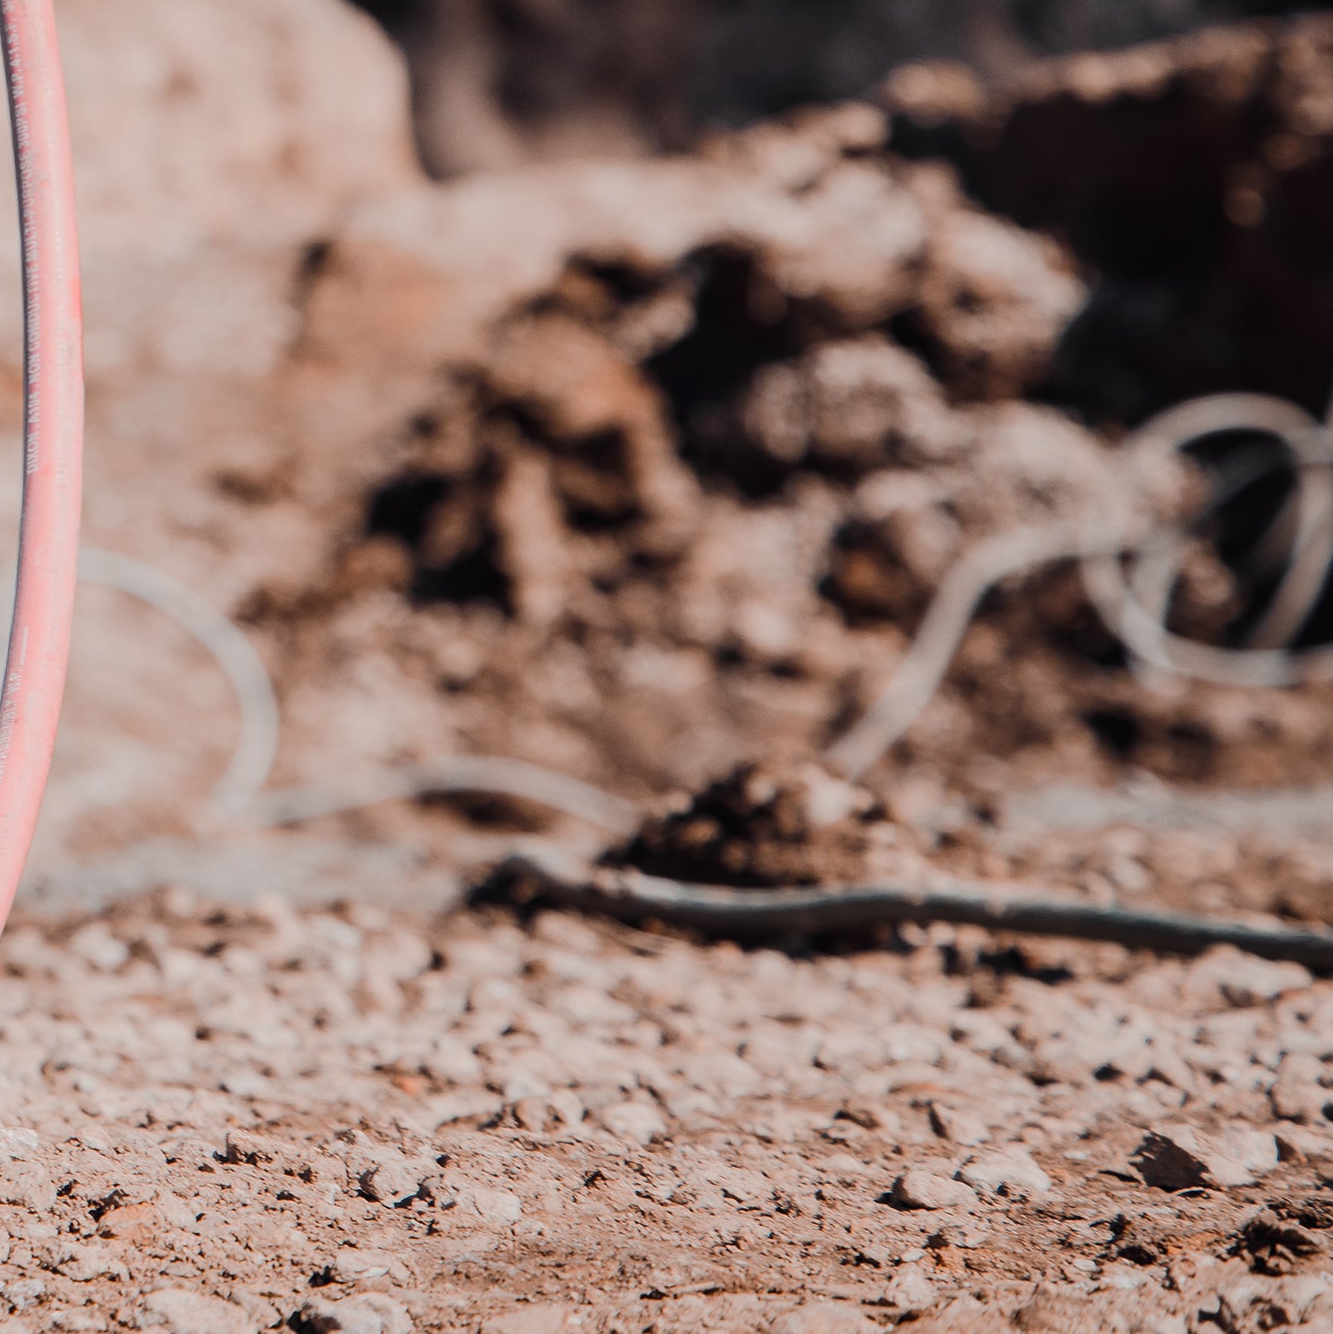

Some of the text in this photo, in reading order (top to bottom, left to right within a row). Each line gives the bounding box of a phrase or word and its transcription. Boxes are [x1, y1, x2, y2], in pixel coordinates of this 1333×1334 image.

[18, 151, 38, 262] MULTI-PURPOSE
[25, 264, 41, 352] CONDUCTIVE
[26, 432, 40, 474] DIXON
